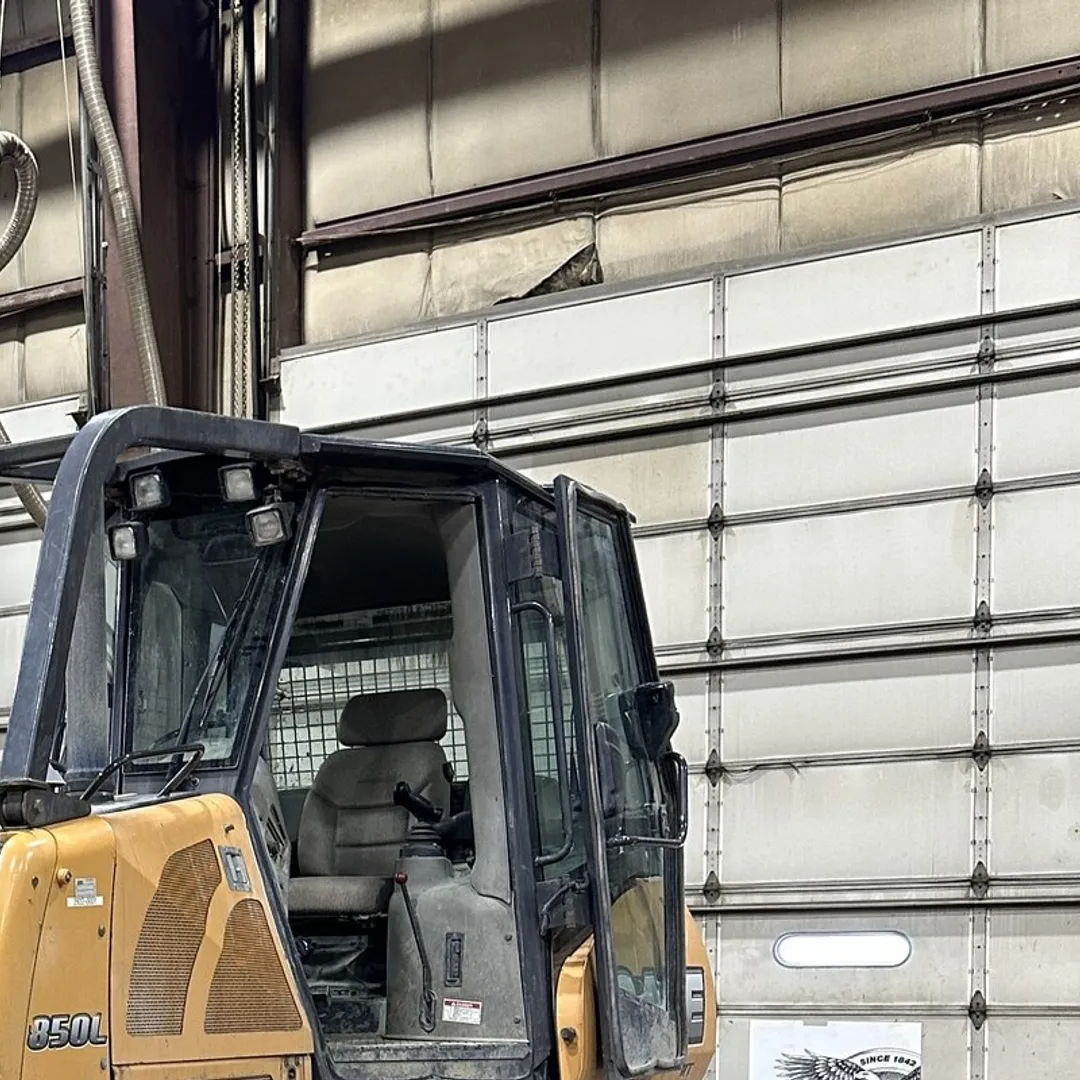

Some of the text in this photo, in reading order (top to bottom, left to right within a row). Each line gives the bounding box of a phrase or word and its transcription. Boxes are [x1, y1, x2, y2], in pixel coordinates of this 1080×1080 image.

[27, 1013, 107, 1050] 850L
[859, 1054, 917, 1067] SINCE 1842
